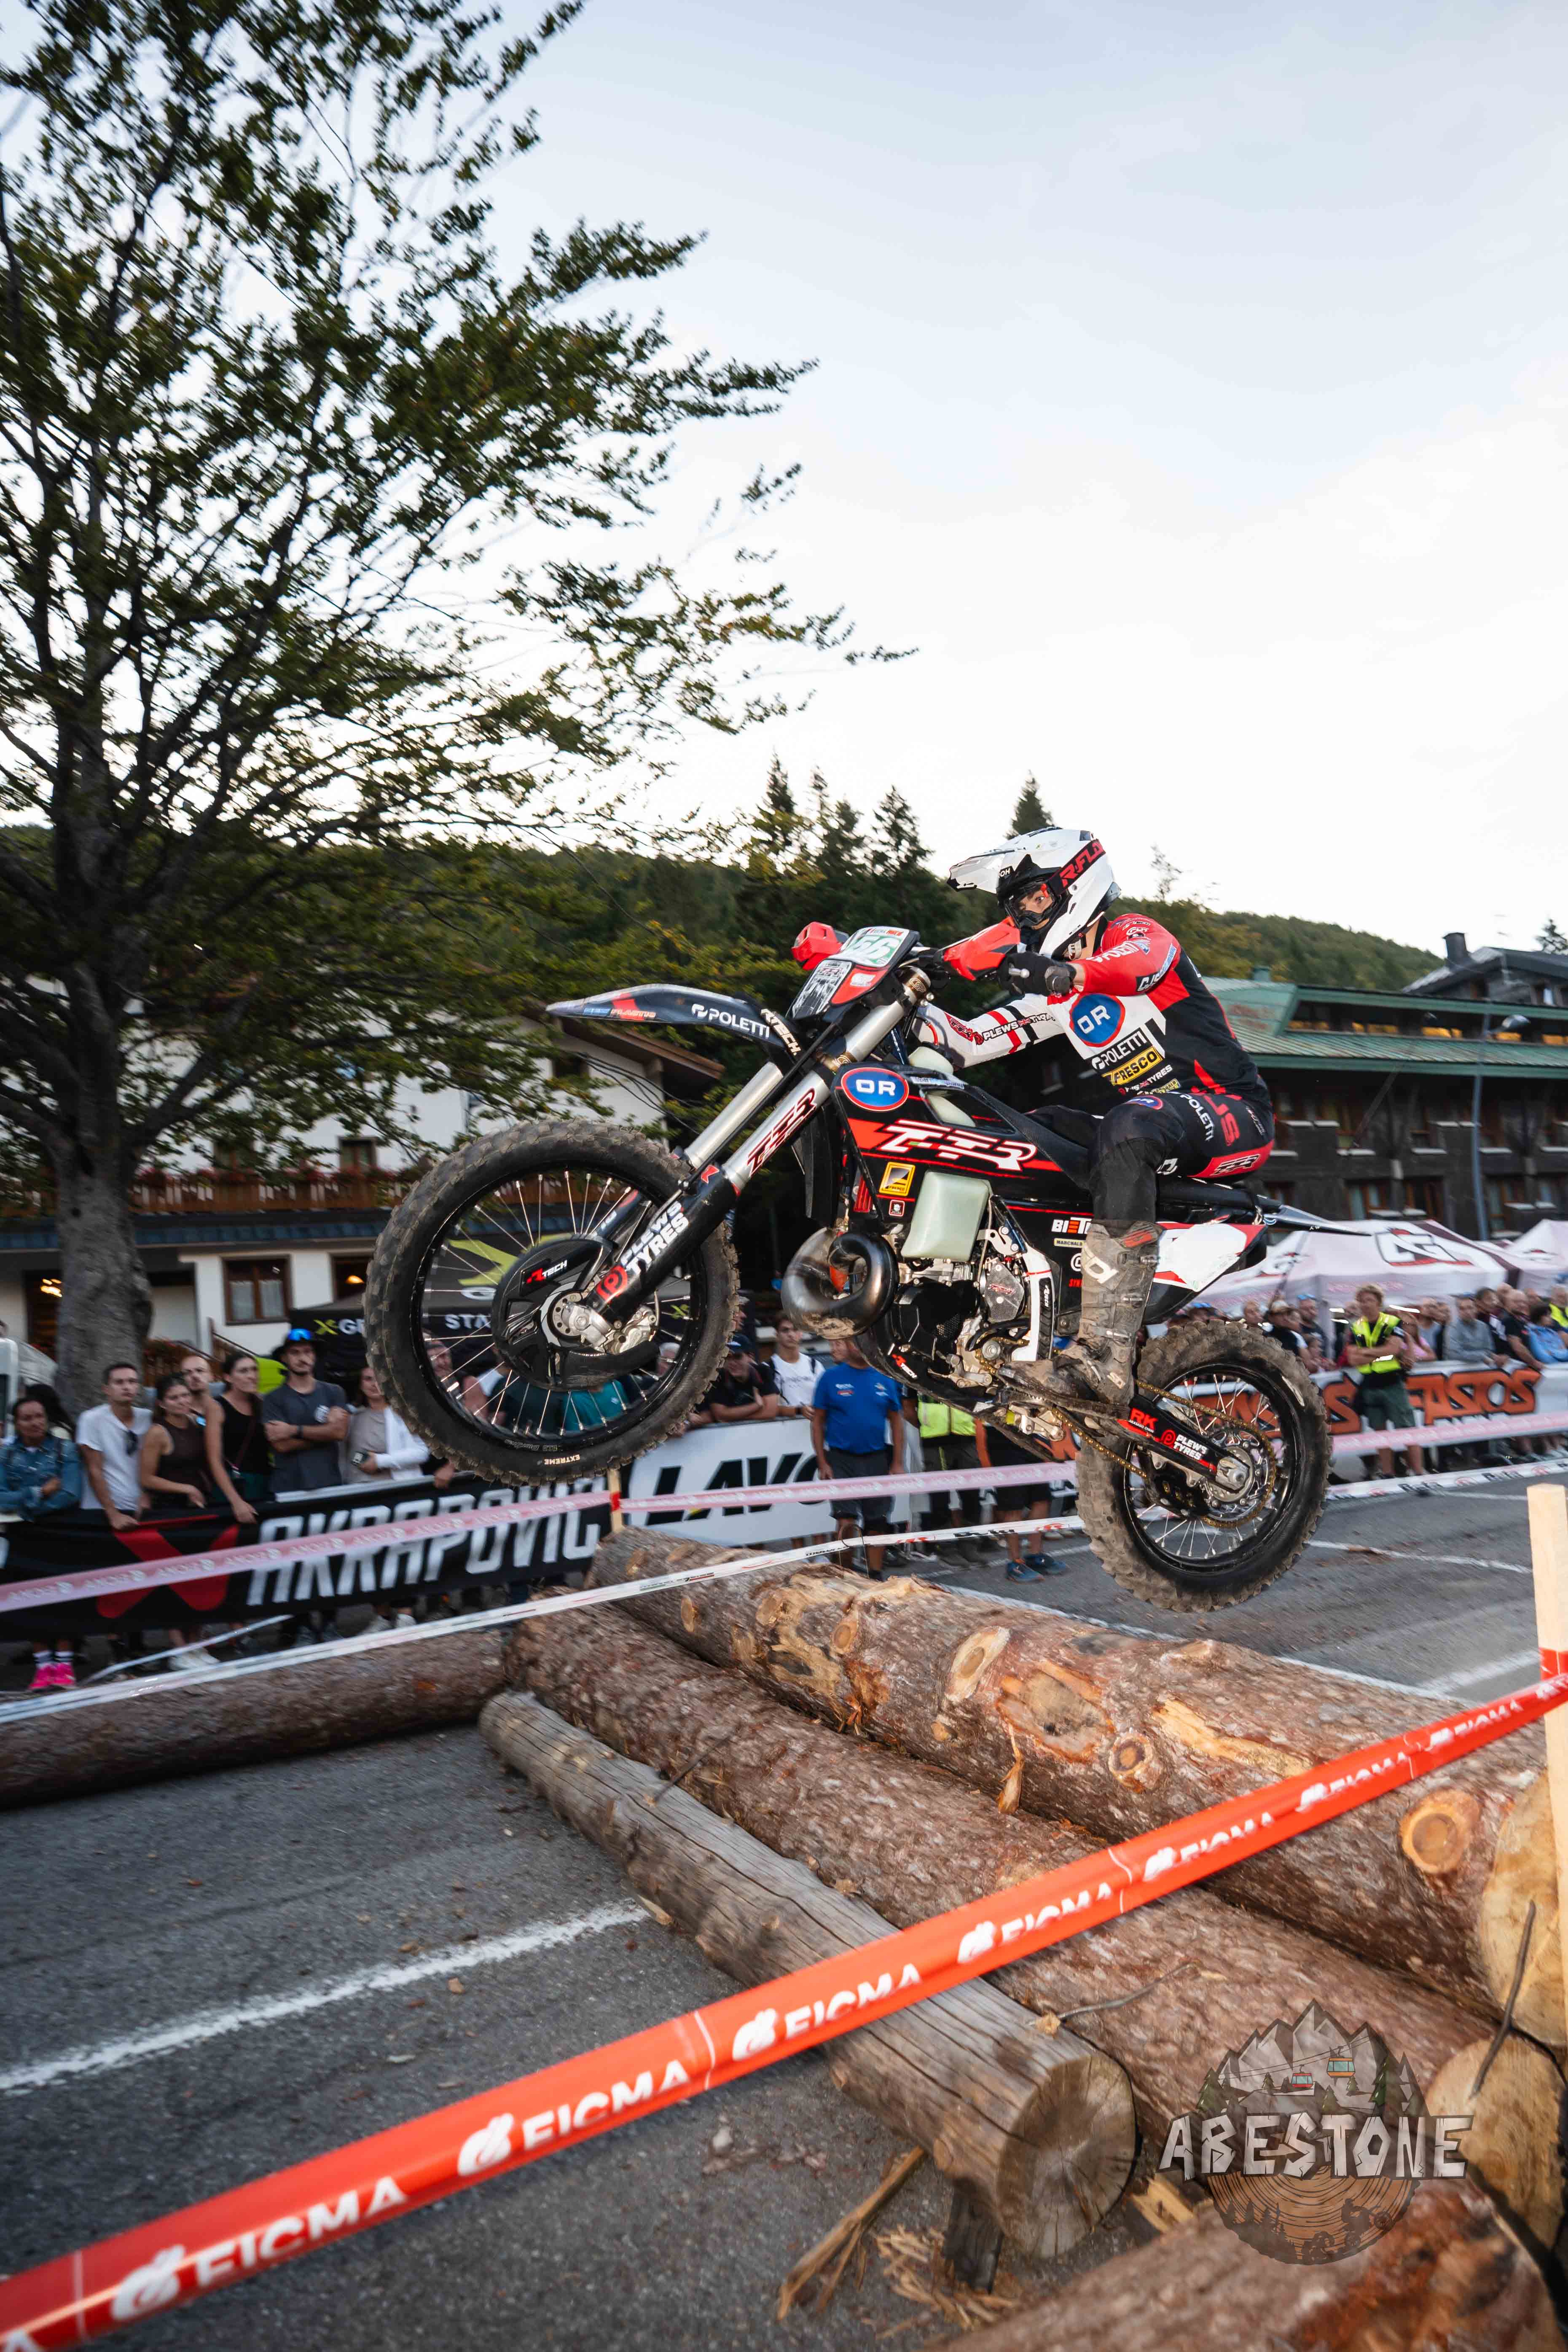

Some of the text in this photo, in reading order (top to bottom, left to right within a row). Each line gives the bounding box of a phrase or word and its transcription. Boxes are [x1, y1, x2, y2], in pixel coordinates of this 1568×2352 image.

[709, 1008, 770, 1039] POLETTI
[983, 1020, 1019, 1041] PLEWS
[1077, 1004, 1110, 1034] OR
[1101, 1031, 1147, 1066] POLETTI
[1114, 1051, 1158, 1083] FRESCO
[1148, 1064, 1173, 1083] TYRES
[856, 1079, 896, 1096] OR
[1180, 1093, 1214, 1141] POLETTI
[620, 1201, 682, 1266] PLEWS
[626, 1212, 690, 1276] TYRES
[1130, 1407, 1158, 1429] RK
[1173, 1442, 1201, 1460] TYRES
[1176, 1434, 1207, 1454] PLEWS
[544, 1454, 580, 1465] EXTREME
[523, 2059, 690, 2149] EICMA
[194, 2175, 407, 2288] EICMA
